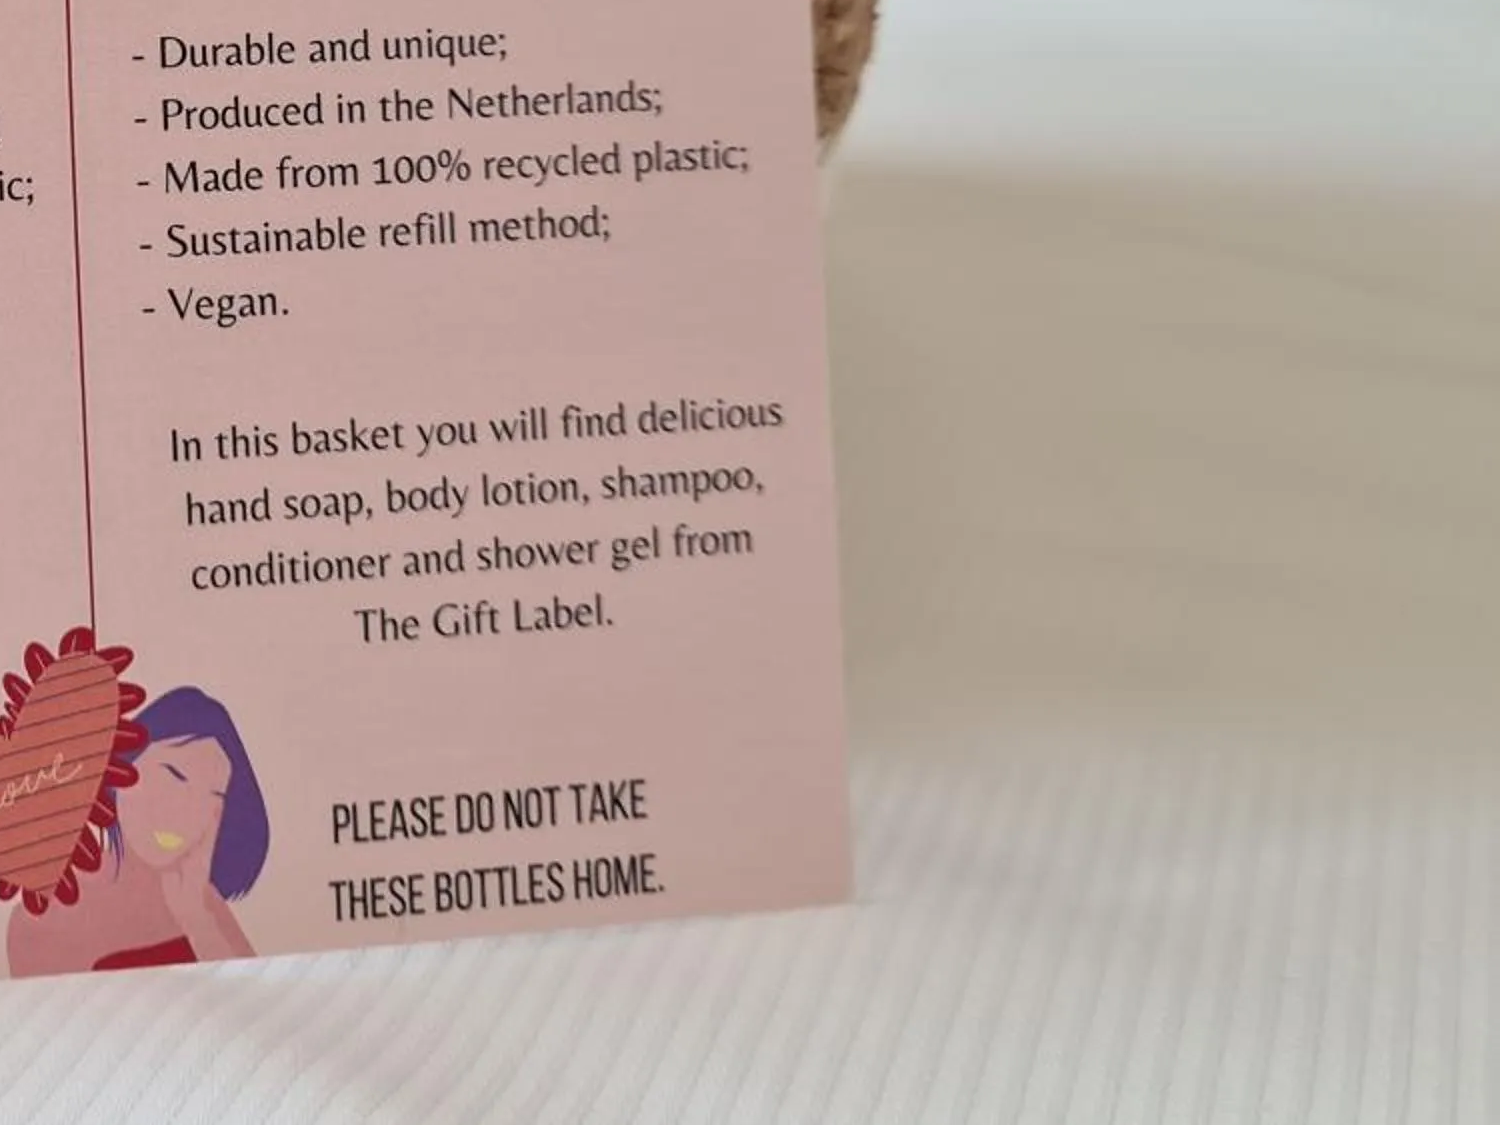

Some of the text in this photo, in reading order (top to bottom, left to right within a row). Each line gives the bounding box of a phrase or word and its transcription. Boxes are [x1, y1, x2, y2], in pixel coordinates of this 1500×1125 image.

[159, 31, 296, 70] Durable
[308, 27, 372, 64] and
[382, 27, 508, 68] unique;
[161, 91, 325, 132] Produced
[336, 93, 367, 124] in
[377, 88, 435, 123] the
[447, 79, 663, 120] Netherlands;
[164, 157, 264, 195] Made
[275, 154, 360, 190] from
[371, 148, 472, 186] 100%
[483, 141, 622, 188] recycled
[631, 139, 749, 183] plastic;
[166, 215, 367, 259] Sustainable
[379, 210, 457, 248] refill
[467, 204, 611, 244] method;
[166, 286, 290, 329] Vegan.
[171, 398, 784, 463] In this basket you will find delicious
[185, 464, 764, 527] hand soap, body lotion, shampoo,
[191, 522, 753, 591] conditioner and shower gel from
[353, 592, 614, 644] The Gift Label.
[331, 778, 649, 845] PLEASE DO NOT TAKE
[327, 852, 665, 923] THESE BOTTLES HOME.
